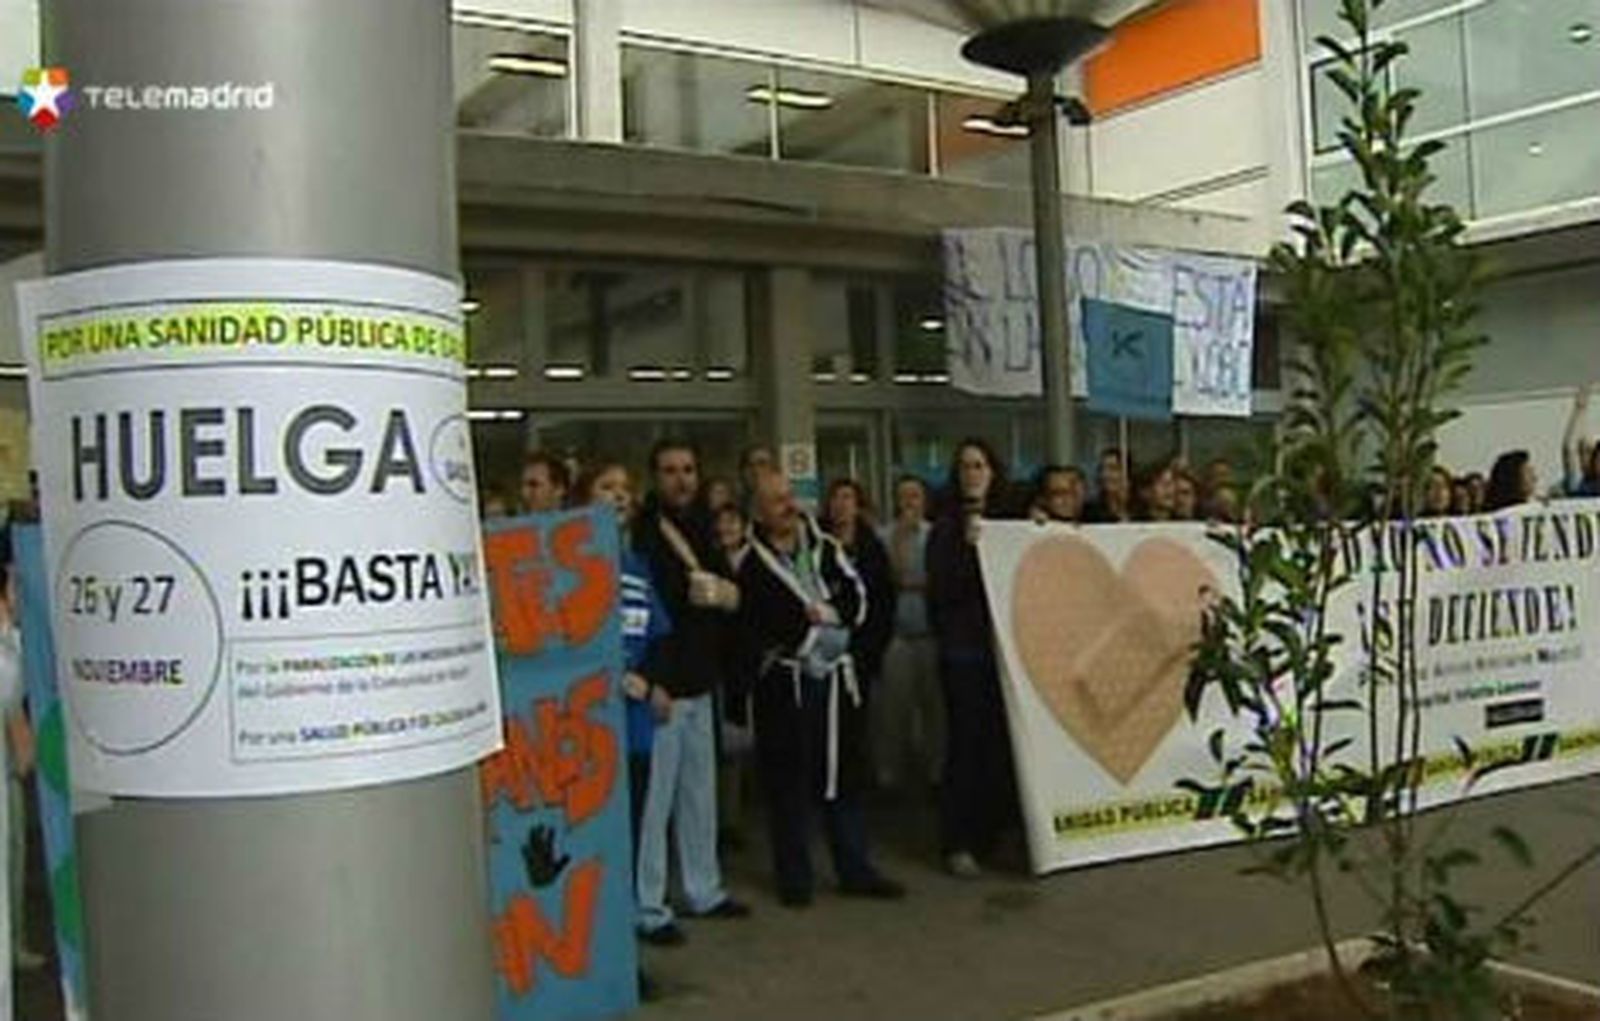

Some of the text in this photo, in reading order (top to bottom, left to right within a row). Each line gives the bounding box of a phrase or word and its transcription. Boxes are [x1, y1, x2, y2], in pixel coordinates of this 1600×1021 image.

[46, 326, 85, 359] POR
[88, 318, 141, 353] UNA
[147, 313, 289, 348] SANIDAD
[300, 311, 409, 353] PÚBLICA
[412, 325, 436, 356] DE
[71, 404, 427, 502] HUELGA
[70, 575, 175, 623] 26 y 27
[72, 657, 184, 686] NOVIEMBRE
